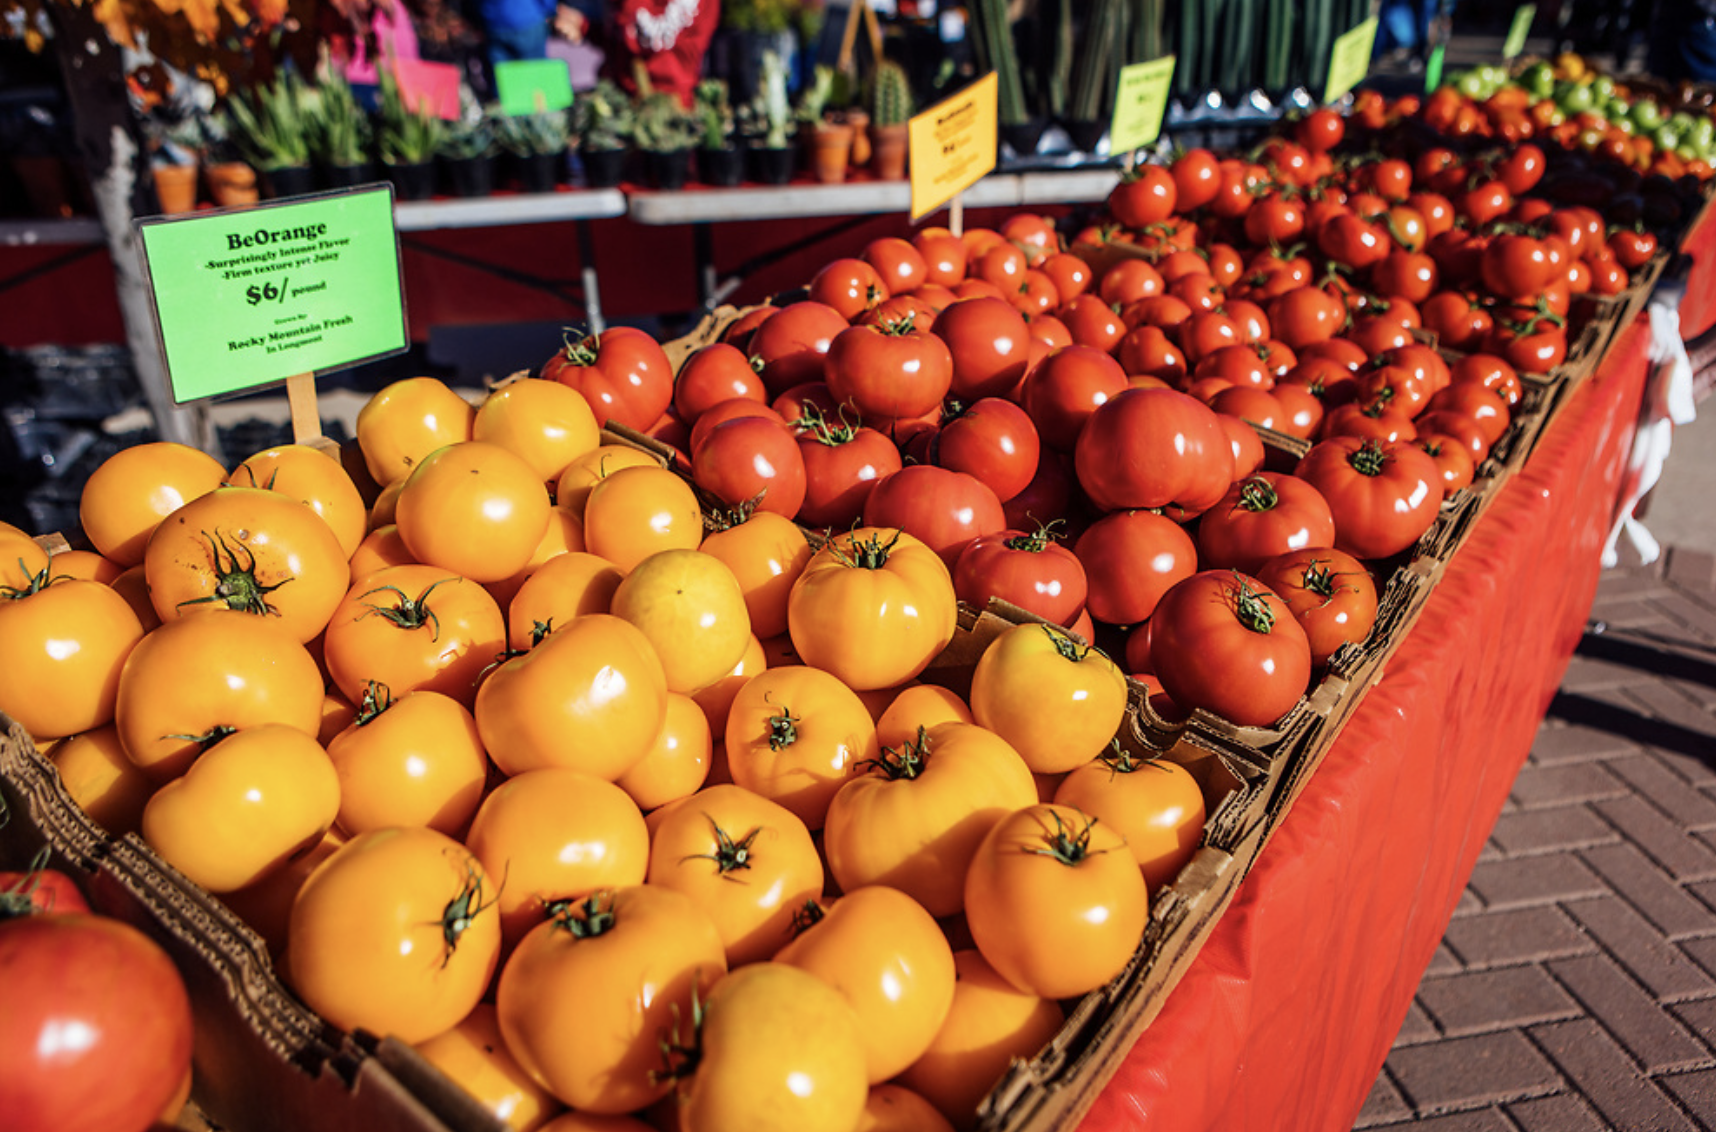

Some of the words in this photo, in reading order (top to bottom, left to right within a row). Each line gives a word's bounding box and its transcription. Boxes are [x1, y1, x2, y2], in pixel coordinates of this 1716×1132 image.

[226, 223, 327, 251] BeOrange
[205, 251, 277, 269] -Surprisingly
[279, 244, 317, 258] Intense
[319, 238, 350, 250] Flavor
[222, 269, 253, 280] -Firm
[254, 261, 293, 275] texture
[295, 258, 311, 268] yet
[313, 251, 339, 263] Juicy
[292, 281, 326, 297] pound
[228, 334, 266, 352] Rocky
[268, 323, 322, 342] Mountain
[323, 315, 353, 329] Fresh
[266, 346, 277, 354] In
[277, 334, 323, 351] Longmont
